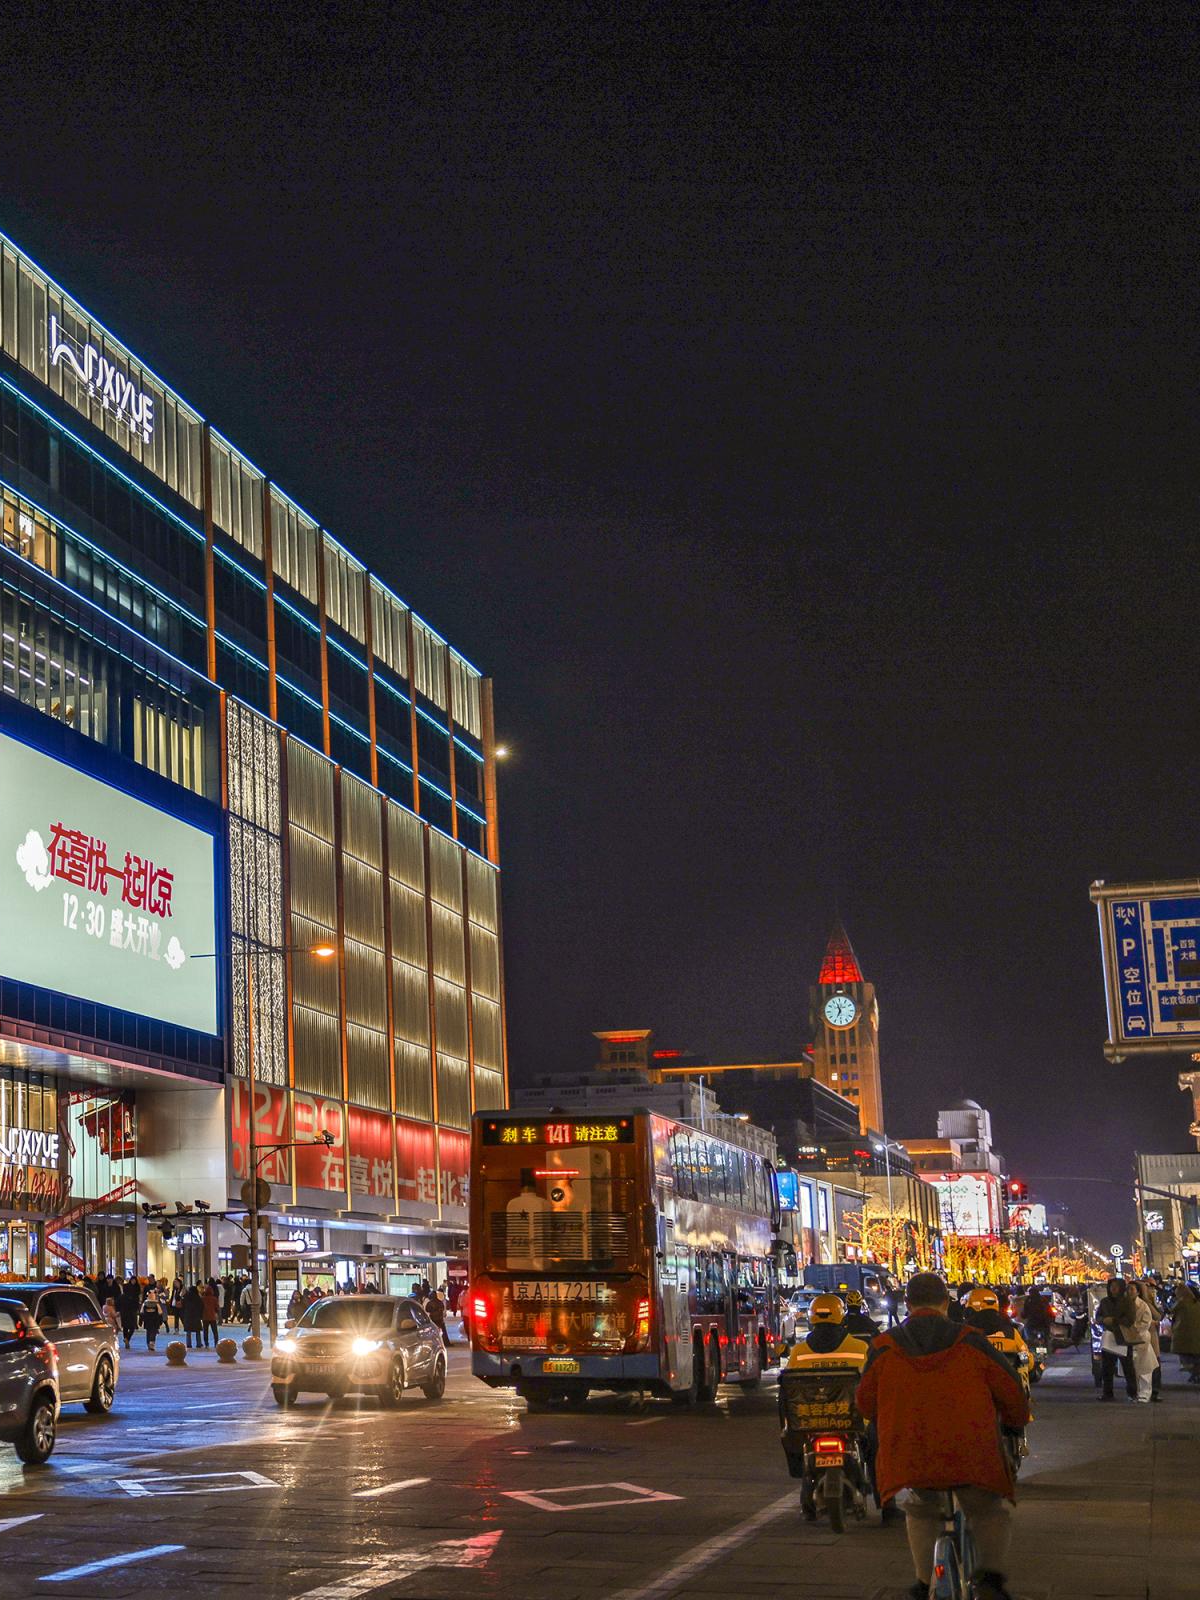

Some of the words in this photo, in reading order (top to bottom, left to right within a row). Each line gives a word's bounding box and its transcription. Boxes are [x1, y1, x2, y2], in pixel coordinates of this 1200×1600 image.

[109, 908, 162, 961] 盛大开业
[1122, 938, 1136, 957] P
[1123, 967, 1143, 1006] 空位
[546, 1124, 570, 1144] 141
[575, 1126, 618, 1142] 请注意
